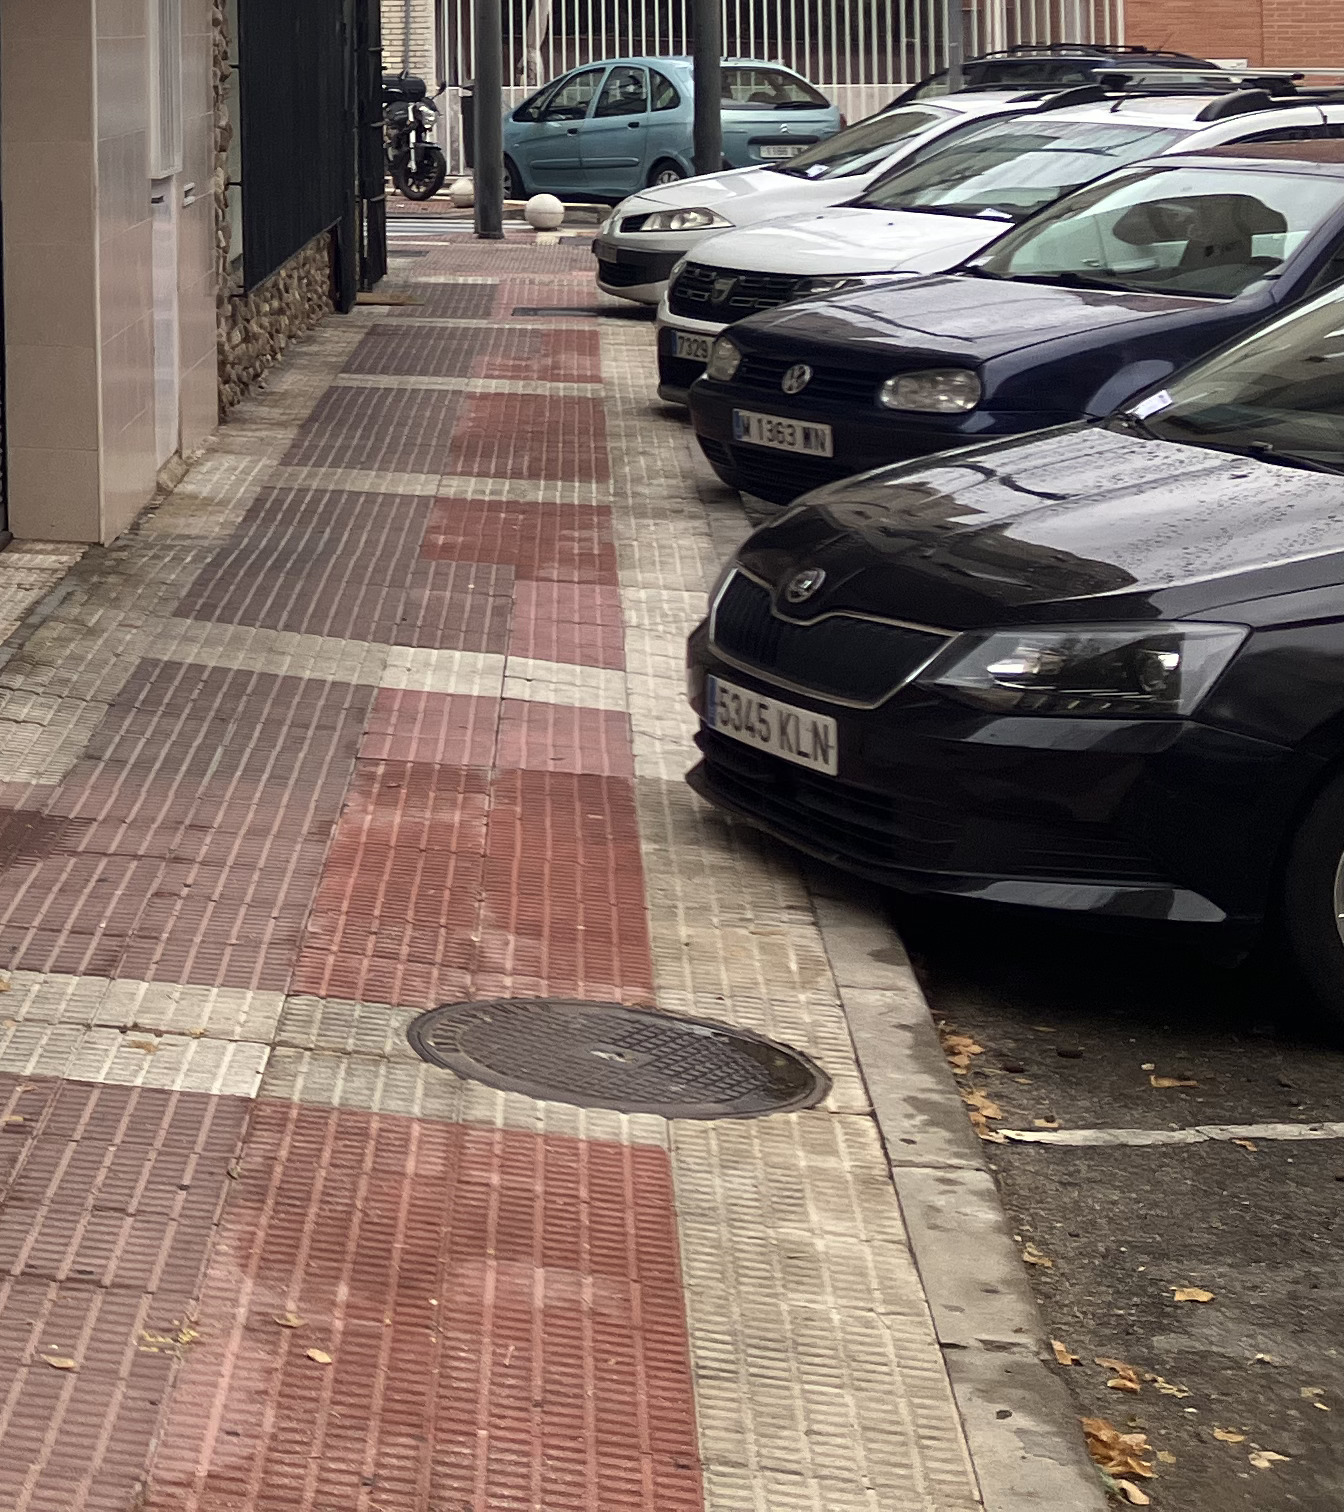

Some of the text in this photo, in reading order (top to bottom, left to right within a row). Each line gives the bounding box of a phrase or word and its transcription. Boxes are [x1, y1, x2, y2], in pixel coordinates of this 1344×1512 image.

[678, 336, 709, 359] 7329
[757, 417, 797, 447] 1363
[716, 685, 830, 766] 5345 KLN
